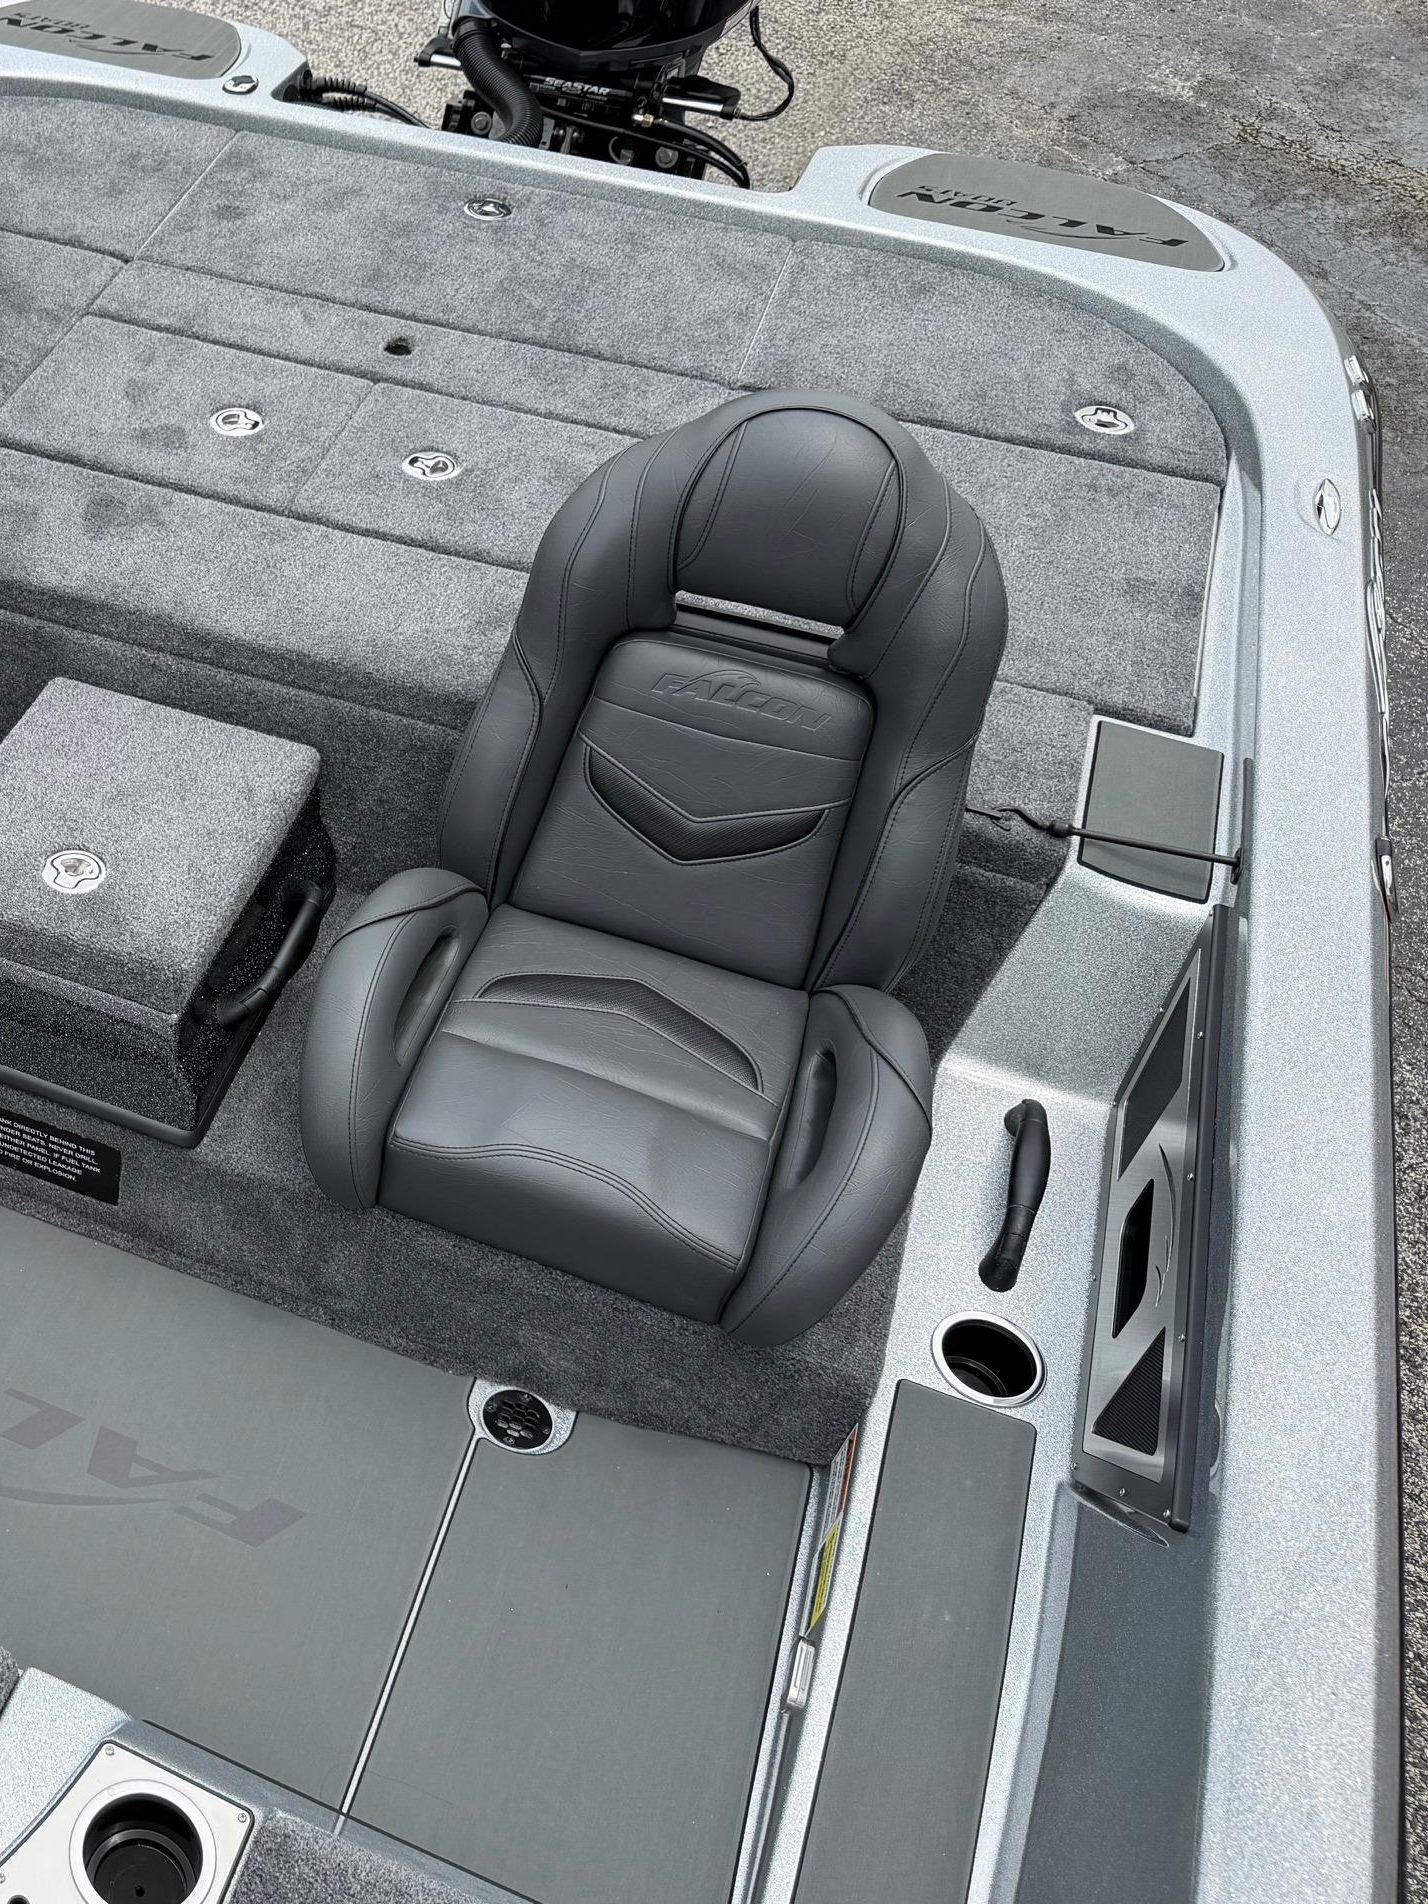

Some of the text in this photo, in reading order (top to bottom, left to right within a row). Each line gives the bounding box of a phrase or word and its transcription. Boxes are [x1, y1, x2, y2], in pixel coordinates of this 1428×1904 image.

[544, 77, 611, 96] SEASTAR
[897, 191, 1188, 247] FALCON
[651, 673, 832, 732] FALCON
[13, 1122, 48, 1139] DIRECTLY
[49, 1135, 77, 1149] BEHIND
[78, 1145, 96, 1156] THIS
[48, 1142, 74, 1156] NEVER
[0, 1132, 26, 1147] EITHER
[61, 1155, 81, 1167] FUEL
[81, 1162, 101, 1173] TANK
[4, 1150, 20, 1161] FIRE
[21, 1157, 33, 1166] OR
[48, 1159, 83, 1175] LEAKAGE
